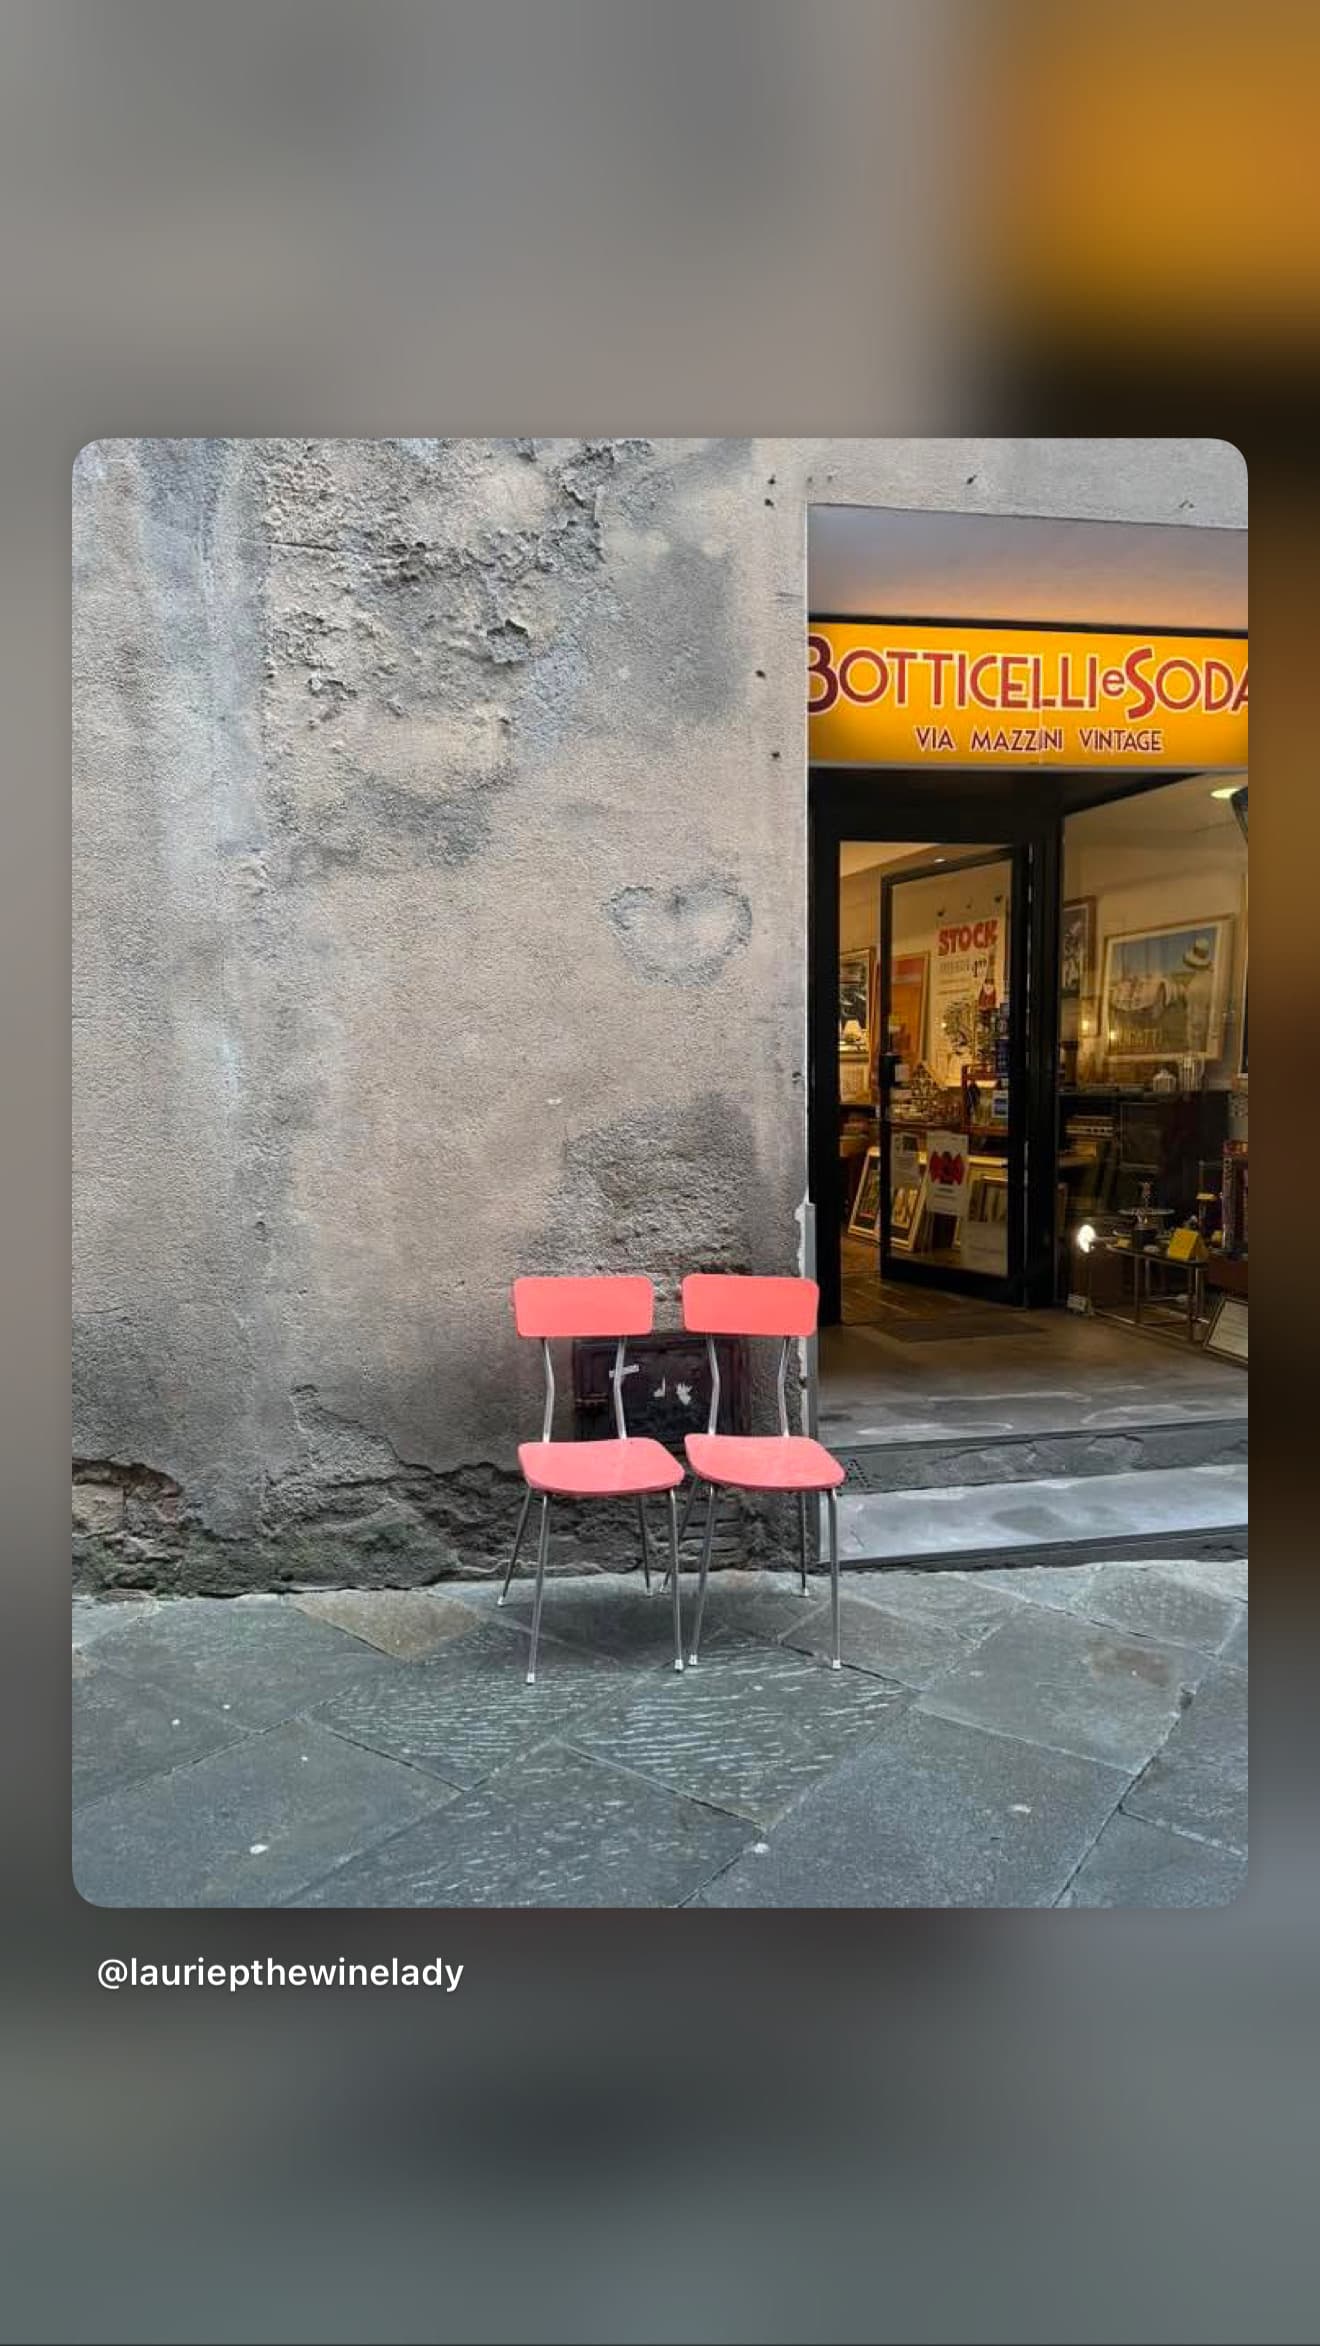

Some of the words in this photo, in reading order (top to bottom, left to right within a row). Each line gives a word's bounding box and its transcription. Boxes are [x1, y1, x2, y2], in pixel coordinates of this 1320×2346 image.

[915, 726, 955, 751] VIA
[970, 728, 1063, 752] MAZZINI
[1079, 728, 1163, 752] VINTAGE
[937, 919, 998, 957] STOCK
